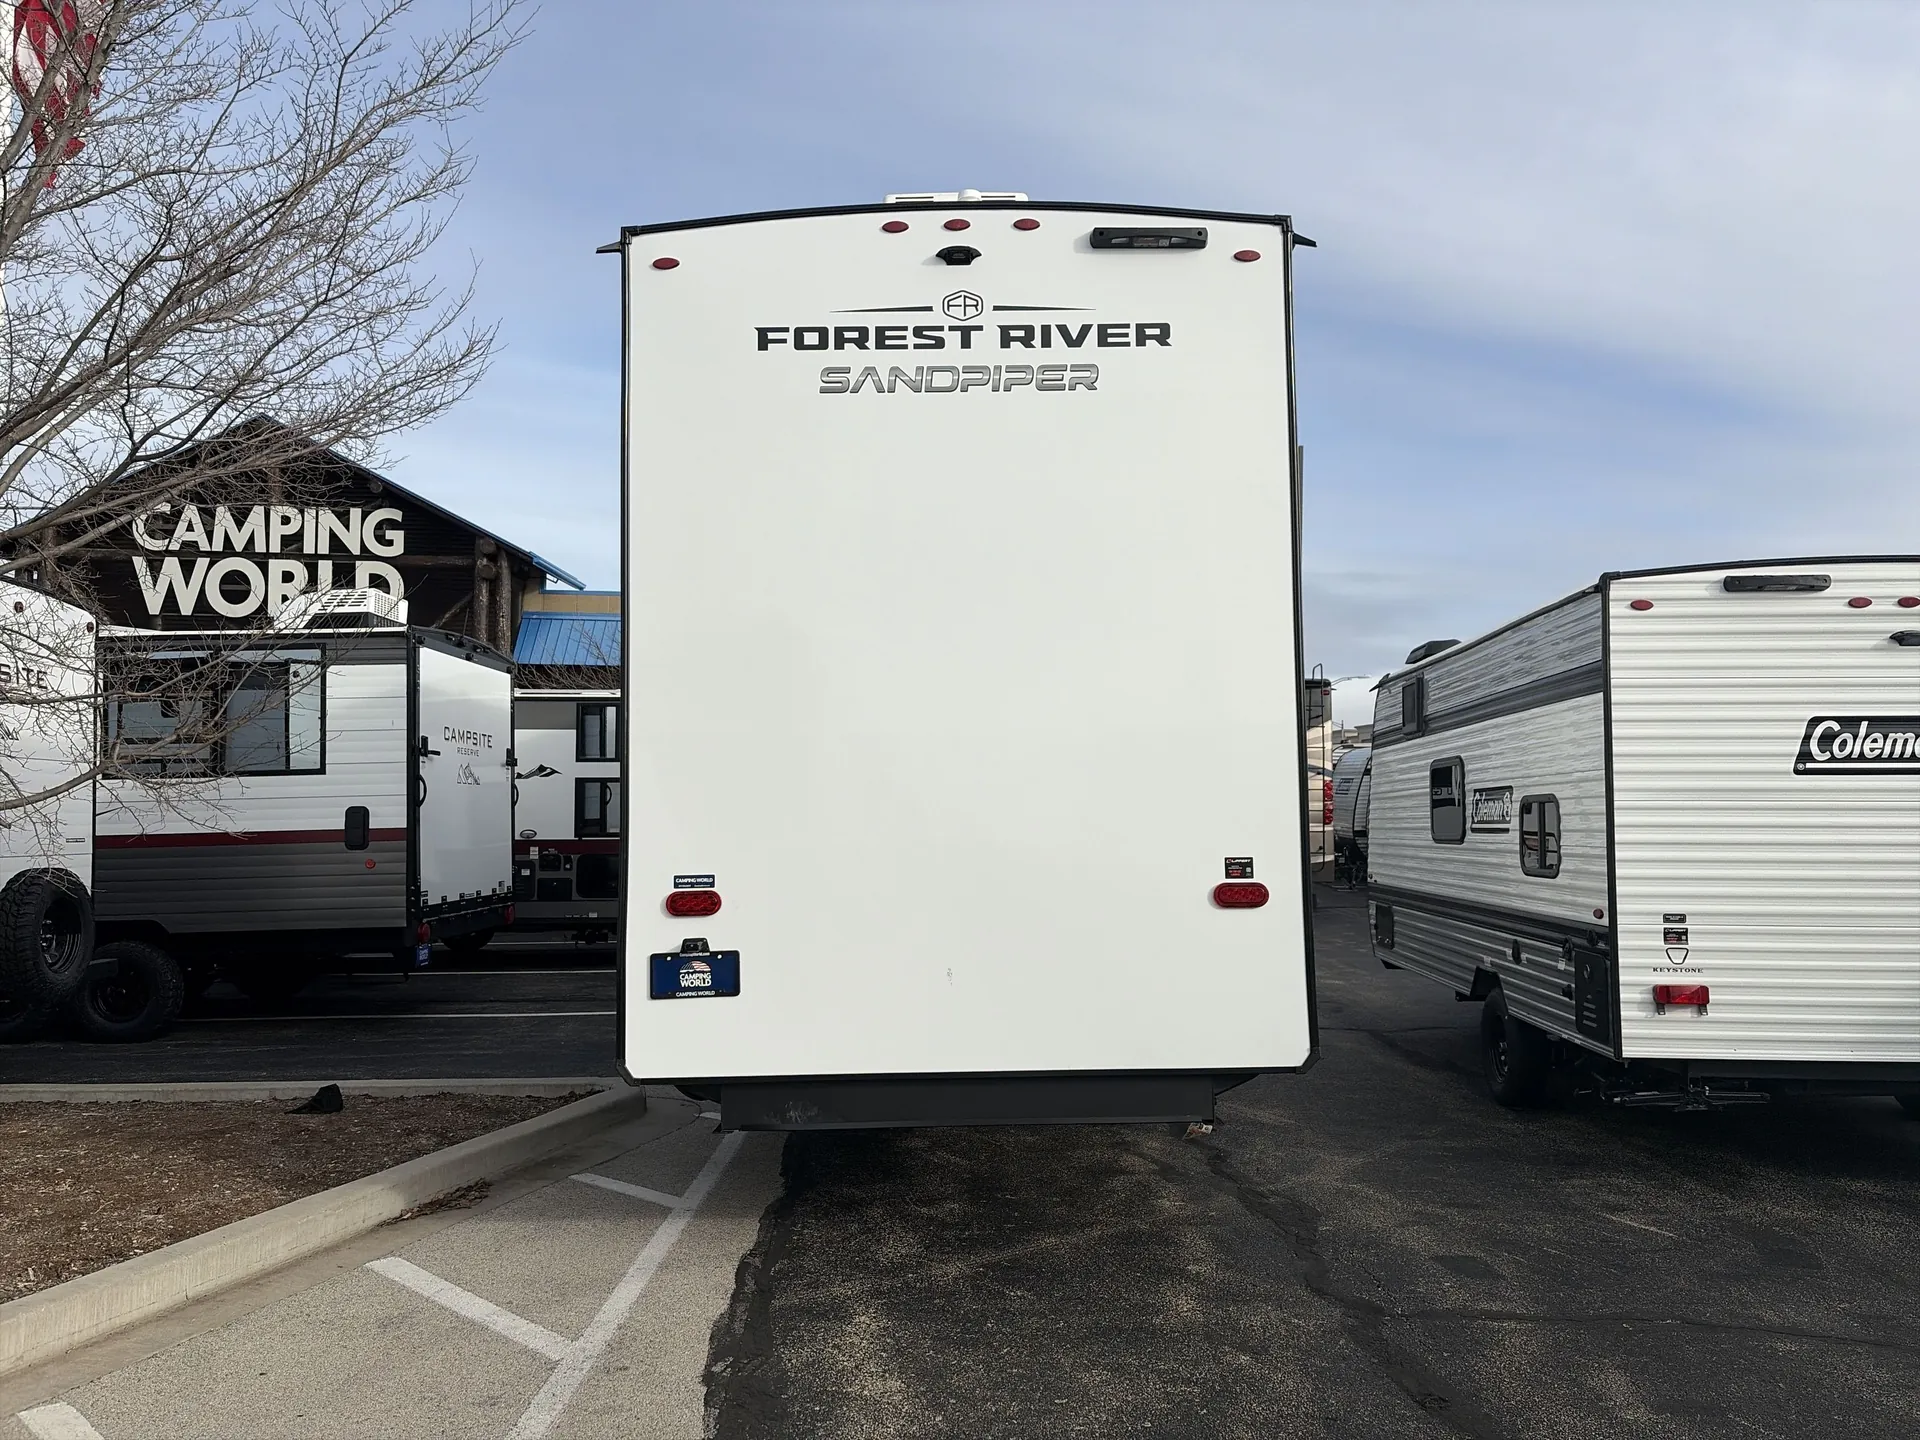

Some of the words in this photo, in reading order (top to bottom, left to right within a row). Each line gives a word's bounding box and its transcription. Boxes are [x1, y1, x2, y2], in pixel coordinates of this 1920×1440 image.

[754, 325, 984, 351] FOREST
[997, 322, 1172, 348] RIVER
[819, 364, 1099, 393] SANDPIPER
[132, 502, 405, 557] CAMPING
[443, 726, 493, 748] CAMPSITE
[457, 746, 480, 757] RESERVE
[1473, 791, 1503, 822] Coleman
[679, 972, 712, 980] CAMPING
[680, 979, 712, 988] WORLD
